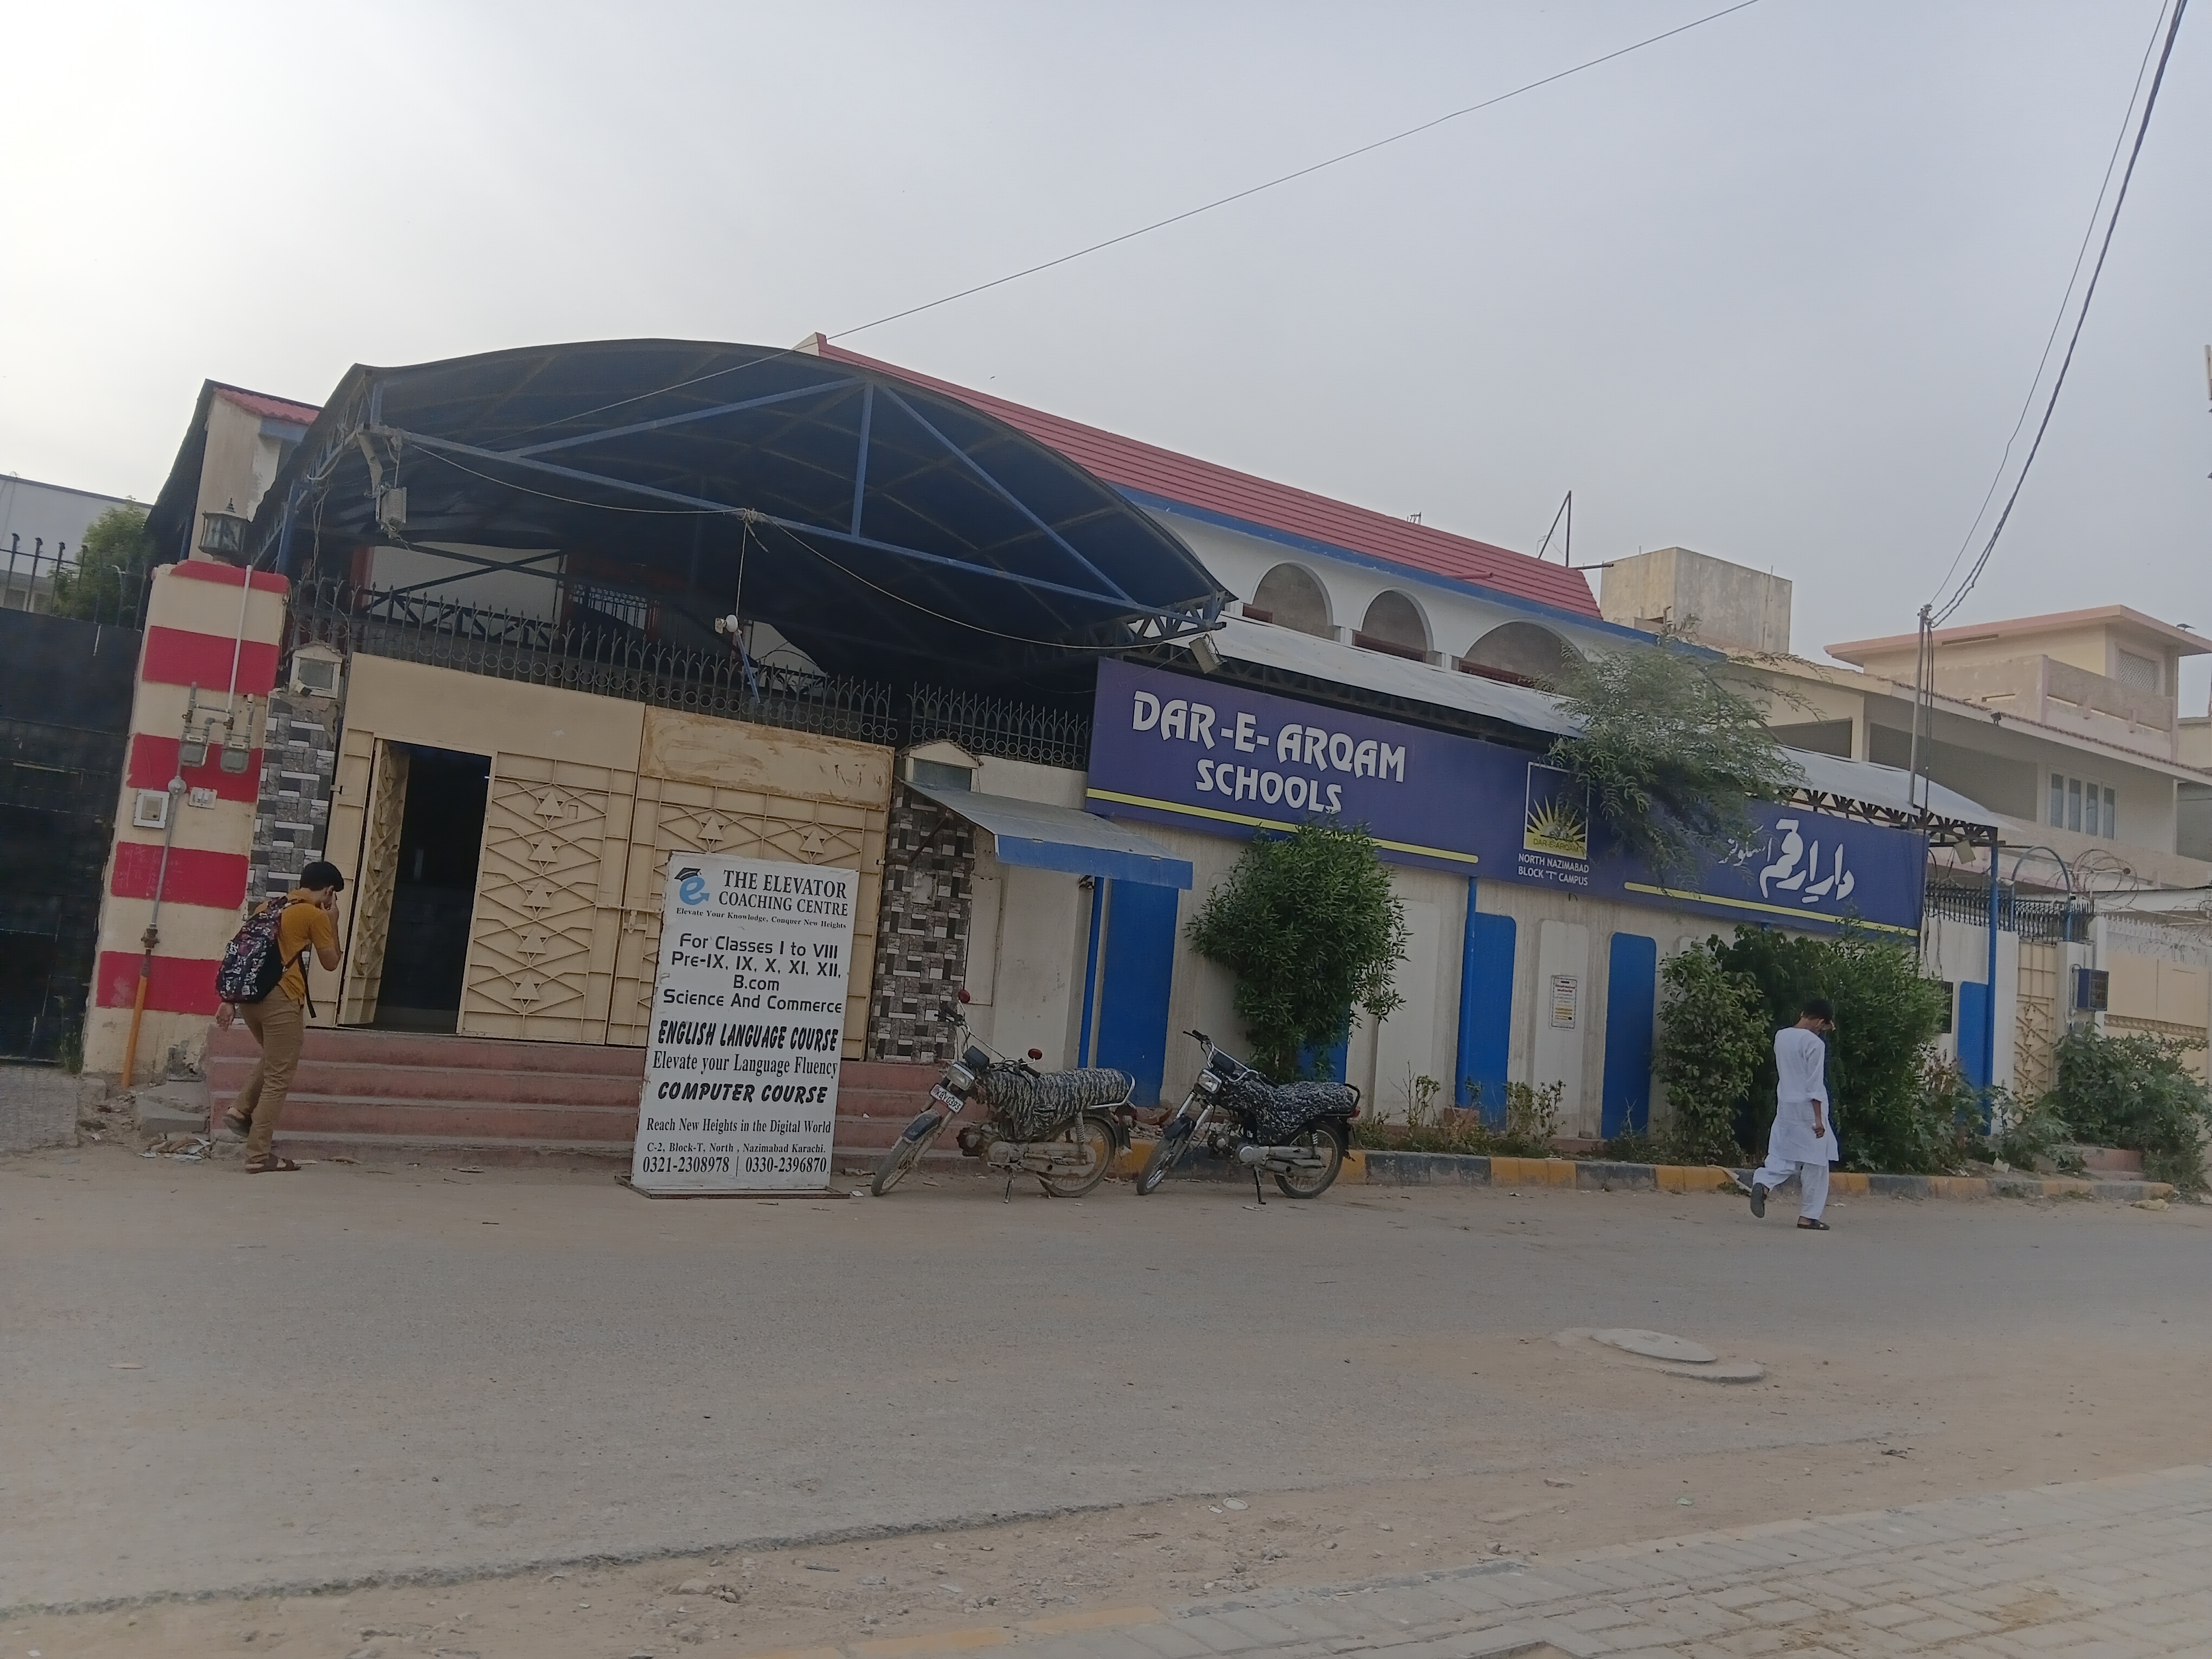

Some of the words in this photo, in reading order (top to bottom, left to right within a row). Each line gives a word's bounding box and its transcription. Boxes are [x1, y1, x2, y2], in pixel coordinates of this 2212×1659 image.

[1133, 690, 1406, 783] DAR-E-ARQAM
[1195, 758, 1342, 814] SCHOOLS
[1518, 853, 1545, 866] NORTH
[1547, 858, 1590, 873] NAZIMABAD
[723, 869, 758, 890] THE
[762, 873, 847, 899] ELEVATOR
[1518, 866, 1544, 879] BLOCK
[1558, 873, 1589, 886] CAMPUS
[719, 891, 792, 911] COACHING
[796, 898, 848, 916] CENTRE
[676, 907, 704, 916] Elevate
[771, 916, 801, 925] Conquer
[821, 921, 846, 929] Heights
[679, 933, 709, 949] For
[715, 935, 773, 954] Classes
[780, 941, 784, 955] I
[790, 941, 806, 956] to
[813, 943, 838, 959] VIII
[671, 950, 728, 970] Pre-IX,
[736, 955, 757, 973] IX,
[764, 957, 781, 974] X,
[788, 960, 809, 976] XI,
[816, 961, 841, 979] XII,
[733, 974, 780, 991] B.com
[663, 988, 724, 1006] Science
[730, 993, 761, 1008] And
[767, 995, 842, 1013] Commerce
[658, 1020, 717, 1046] ENGLISH
[719, 1023, 787, 1049] LANGUAGE
[790, 1027, 839, 1053] COURSE
[652, 1050, 697, 1070] Elevate
[700, 1057, 730, 1075] your
[733, 1053, 790, 1077] Language
[794, 1056, 838, 1079] Fluency
[658, 1082, 755, 1103] COMPUTER
[761, 1084, 828, 1104] COURSE
[646, 1117, 676, 1131] Reach
[679, 1118, 699, 1131] New
[702, 1118, 738, 1135] Heights
[741, 1119, 749, 1131] in
[753, 1120, 767, 1132] the
[770, 1120, 801, 1135] Digital
[804, 1120, 831, 1133] World
[647, 1142, 665, 1153] C-2,
[743, 1143, 789, 1153] Nazimabad
[791, 1143, 826, 1153] Karachi.
[642, 1156, 729, 1173] 0321-2308978
